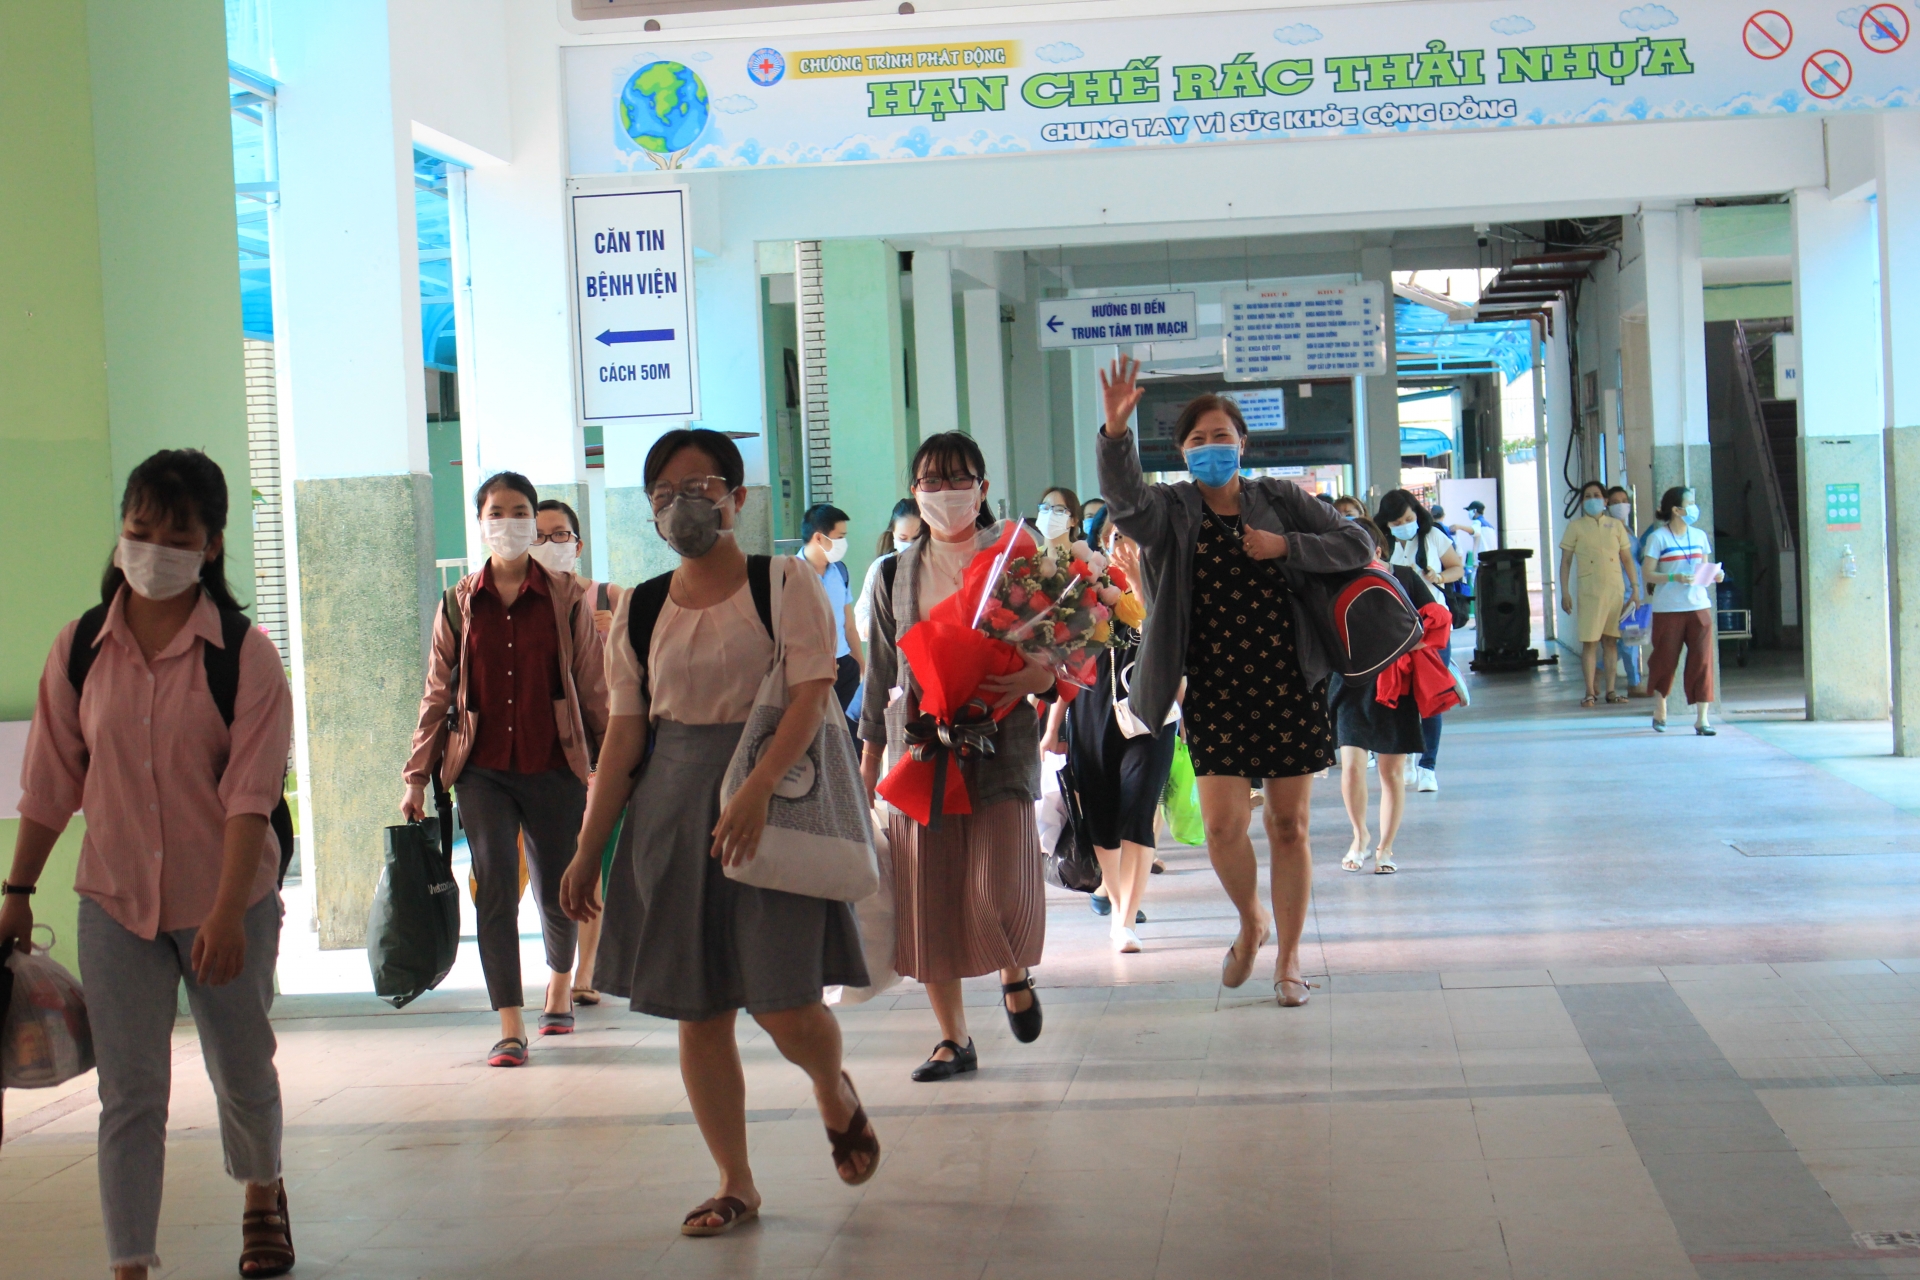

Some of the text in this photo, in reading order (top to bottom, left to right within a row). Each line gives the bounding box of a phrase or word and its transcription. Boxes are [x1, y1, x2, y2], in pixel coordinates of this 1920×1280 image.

[799, 56, 863, 73] CHƯƠNG
[866, 51, 913, 70] TRÌNH
[917, 48, 960, 68] PHÁT
[963, 46, 1006, 67] ĐỘNG
[867, 36, 1695, 122] HẠN CHẾ RÁC THẢI NHỰA
[1041, 95, 1517, 142] CHUNG TAY VÌ SỨC KHỎE CỘNG ĐỒNG
[594, 227, 665, 254] CĂN TIN
[586, 267, 677, 302] BỆNH VIỆN
[1091, 298, 1166, 318] HƯỚNG ĐI ĐẾN
[1071, 320, 1188, 340] TRUNG TÂM TIM MẠCH
[599, 362, 671, 383] CÁCH 50M
